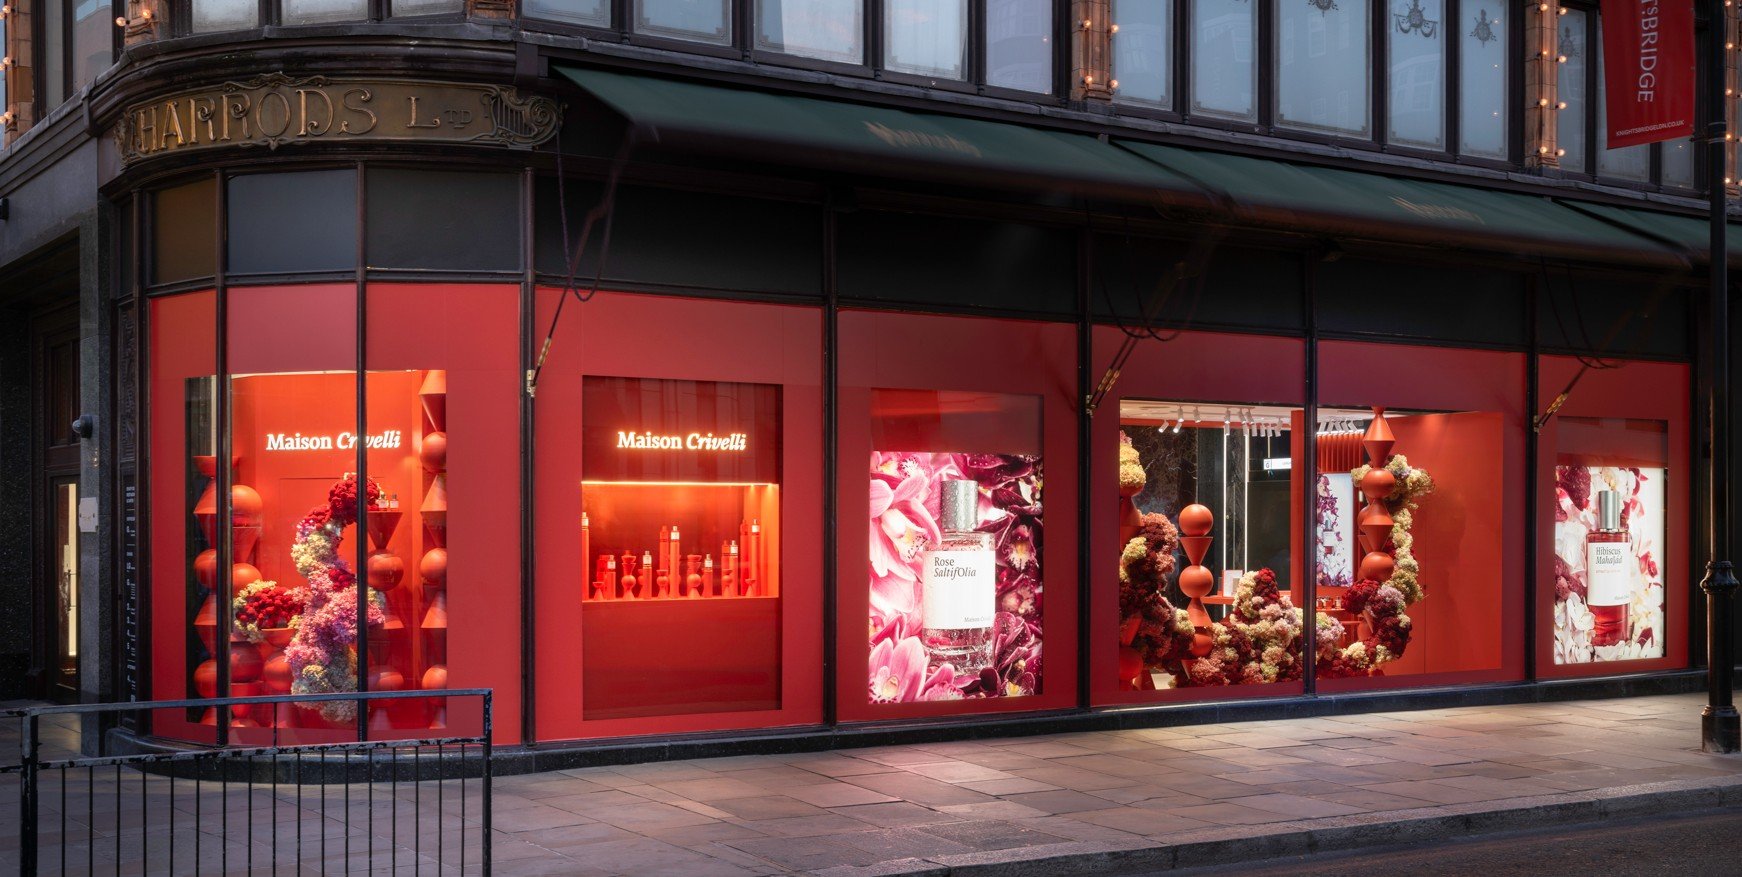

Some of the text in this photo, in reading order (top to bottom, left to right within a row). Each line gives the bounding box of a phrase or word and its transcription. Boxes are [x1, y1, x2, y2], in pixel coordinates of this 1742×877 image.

[132, 88, 377, 153] HARRODS
[266, 430, 401, 451] Maison Crvelli
[617, 431, 747, 451] Maison Crivelli
[1595, 546, 1621, 556] Hibiscus
[934, 556, 955, 567] Rose
